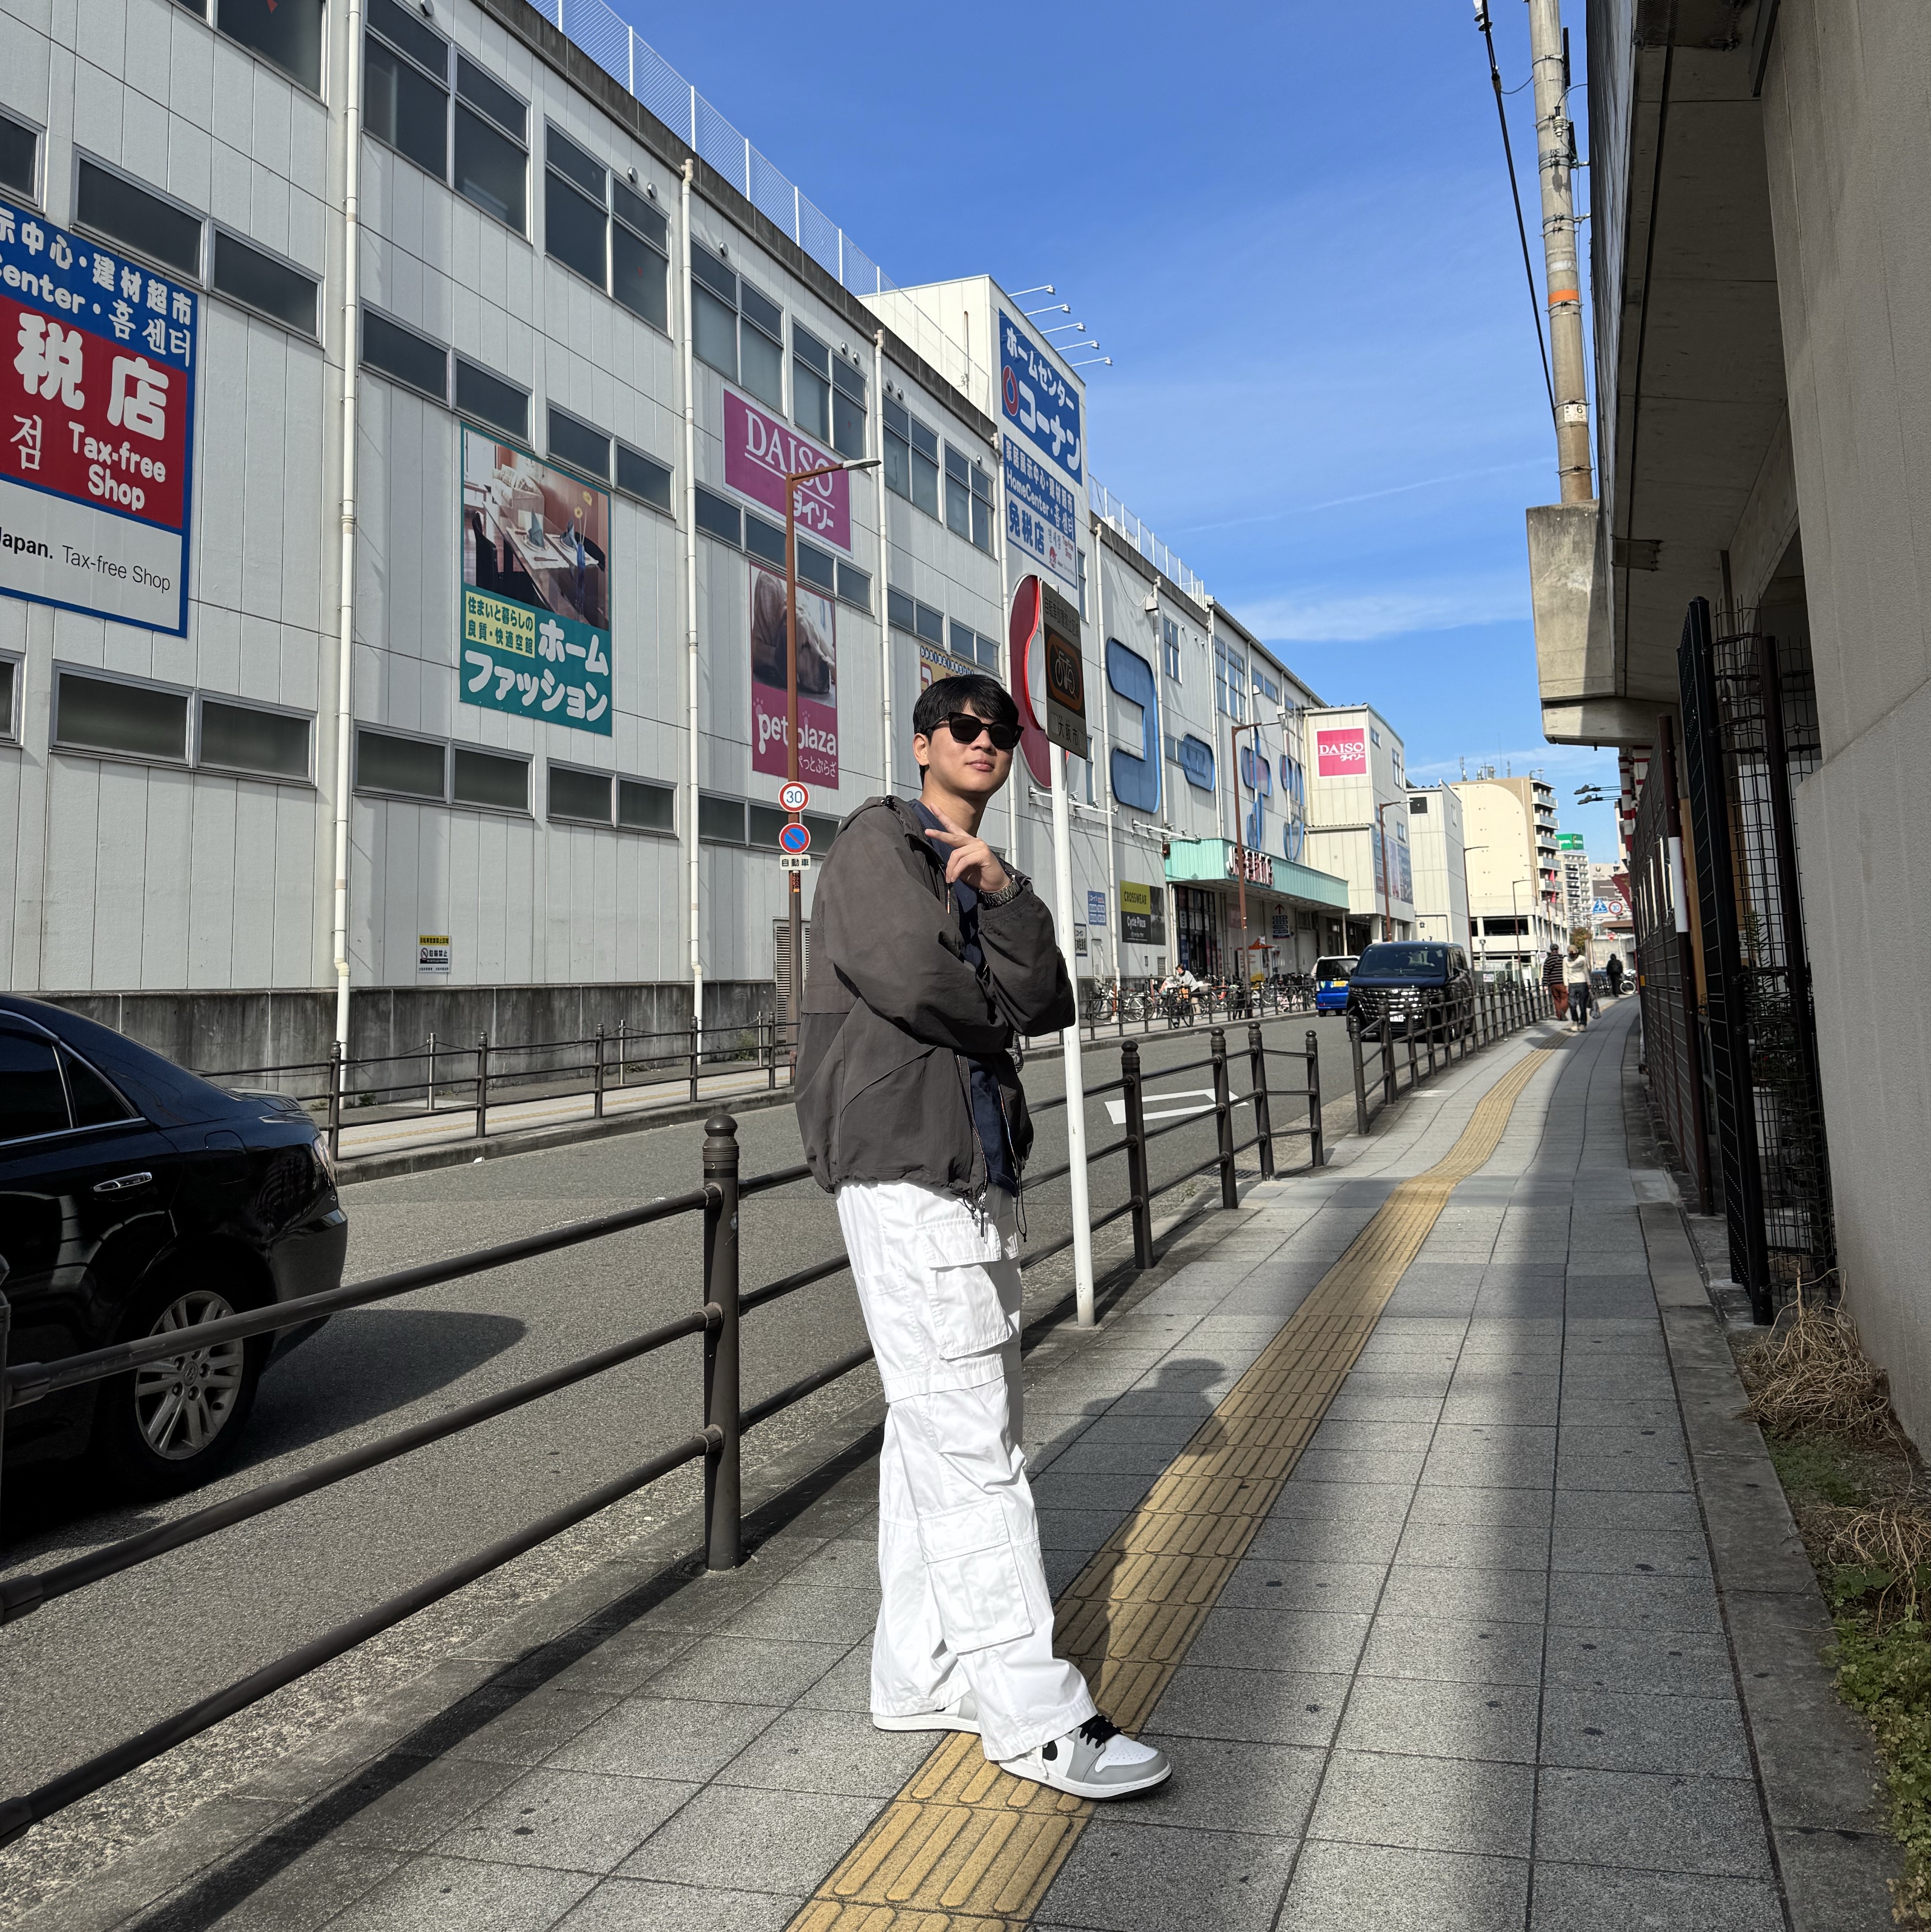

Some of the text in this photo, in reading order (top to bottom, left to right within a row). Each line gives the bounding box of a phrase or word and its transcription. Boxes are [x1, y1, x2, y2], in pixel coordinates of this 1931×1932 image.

[0, 253, 85, 314] enter
[108, 299, 190, 367] 홈 센터
[1007, 327, 1074, 410] ホームセンター
[1019, 380, 1080, 470] コーナン
[1577, 405, 1583, 413] 6
[10, 415, 42, 470] 점
[69, 421, 165, 482] Tax-free
[745, 408, 833, 497] DAISO
[88, 464, 145, 511] Shop
[1009, 500, 1044, 555] 免税店
[62, 545, 127, 578] Tax-free
[133, 565, 170, 593] Shop
[468, 596, 533, 632] 住まいと暮らしの
[538, 619, 609, 676] ホーム
[465, 650, 608, 721] ファッション
[758, 713, 789, 754] pet
[1319, 742, 1364, 754] DAISO
[786, 790, 802, 803] 30
[782, 858, 809, 867] 自動車
